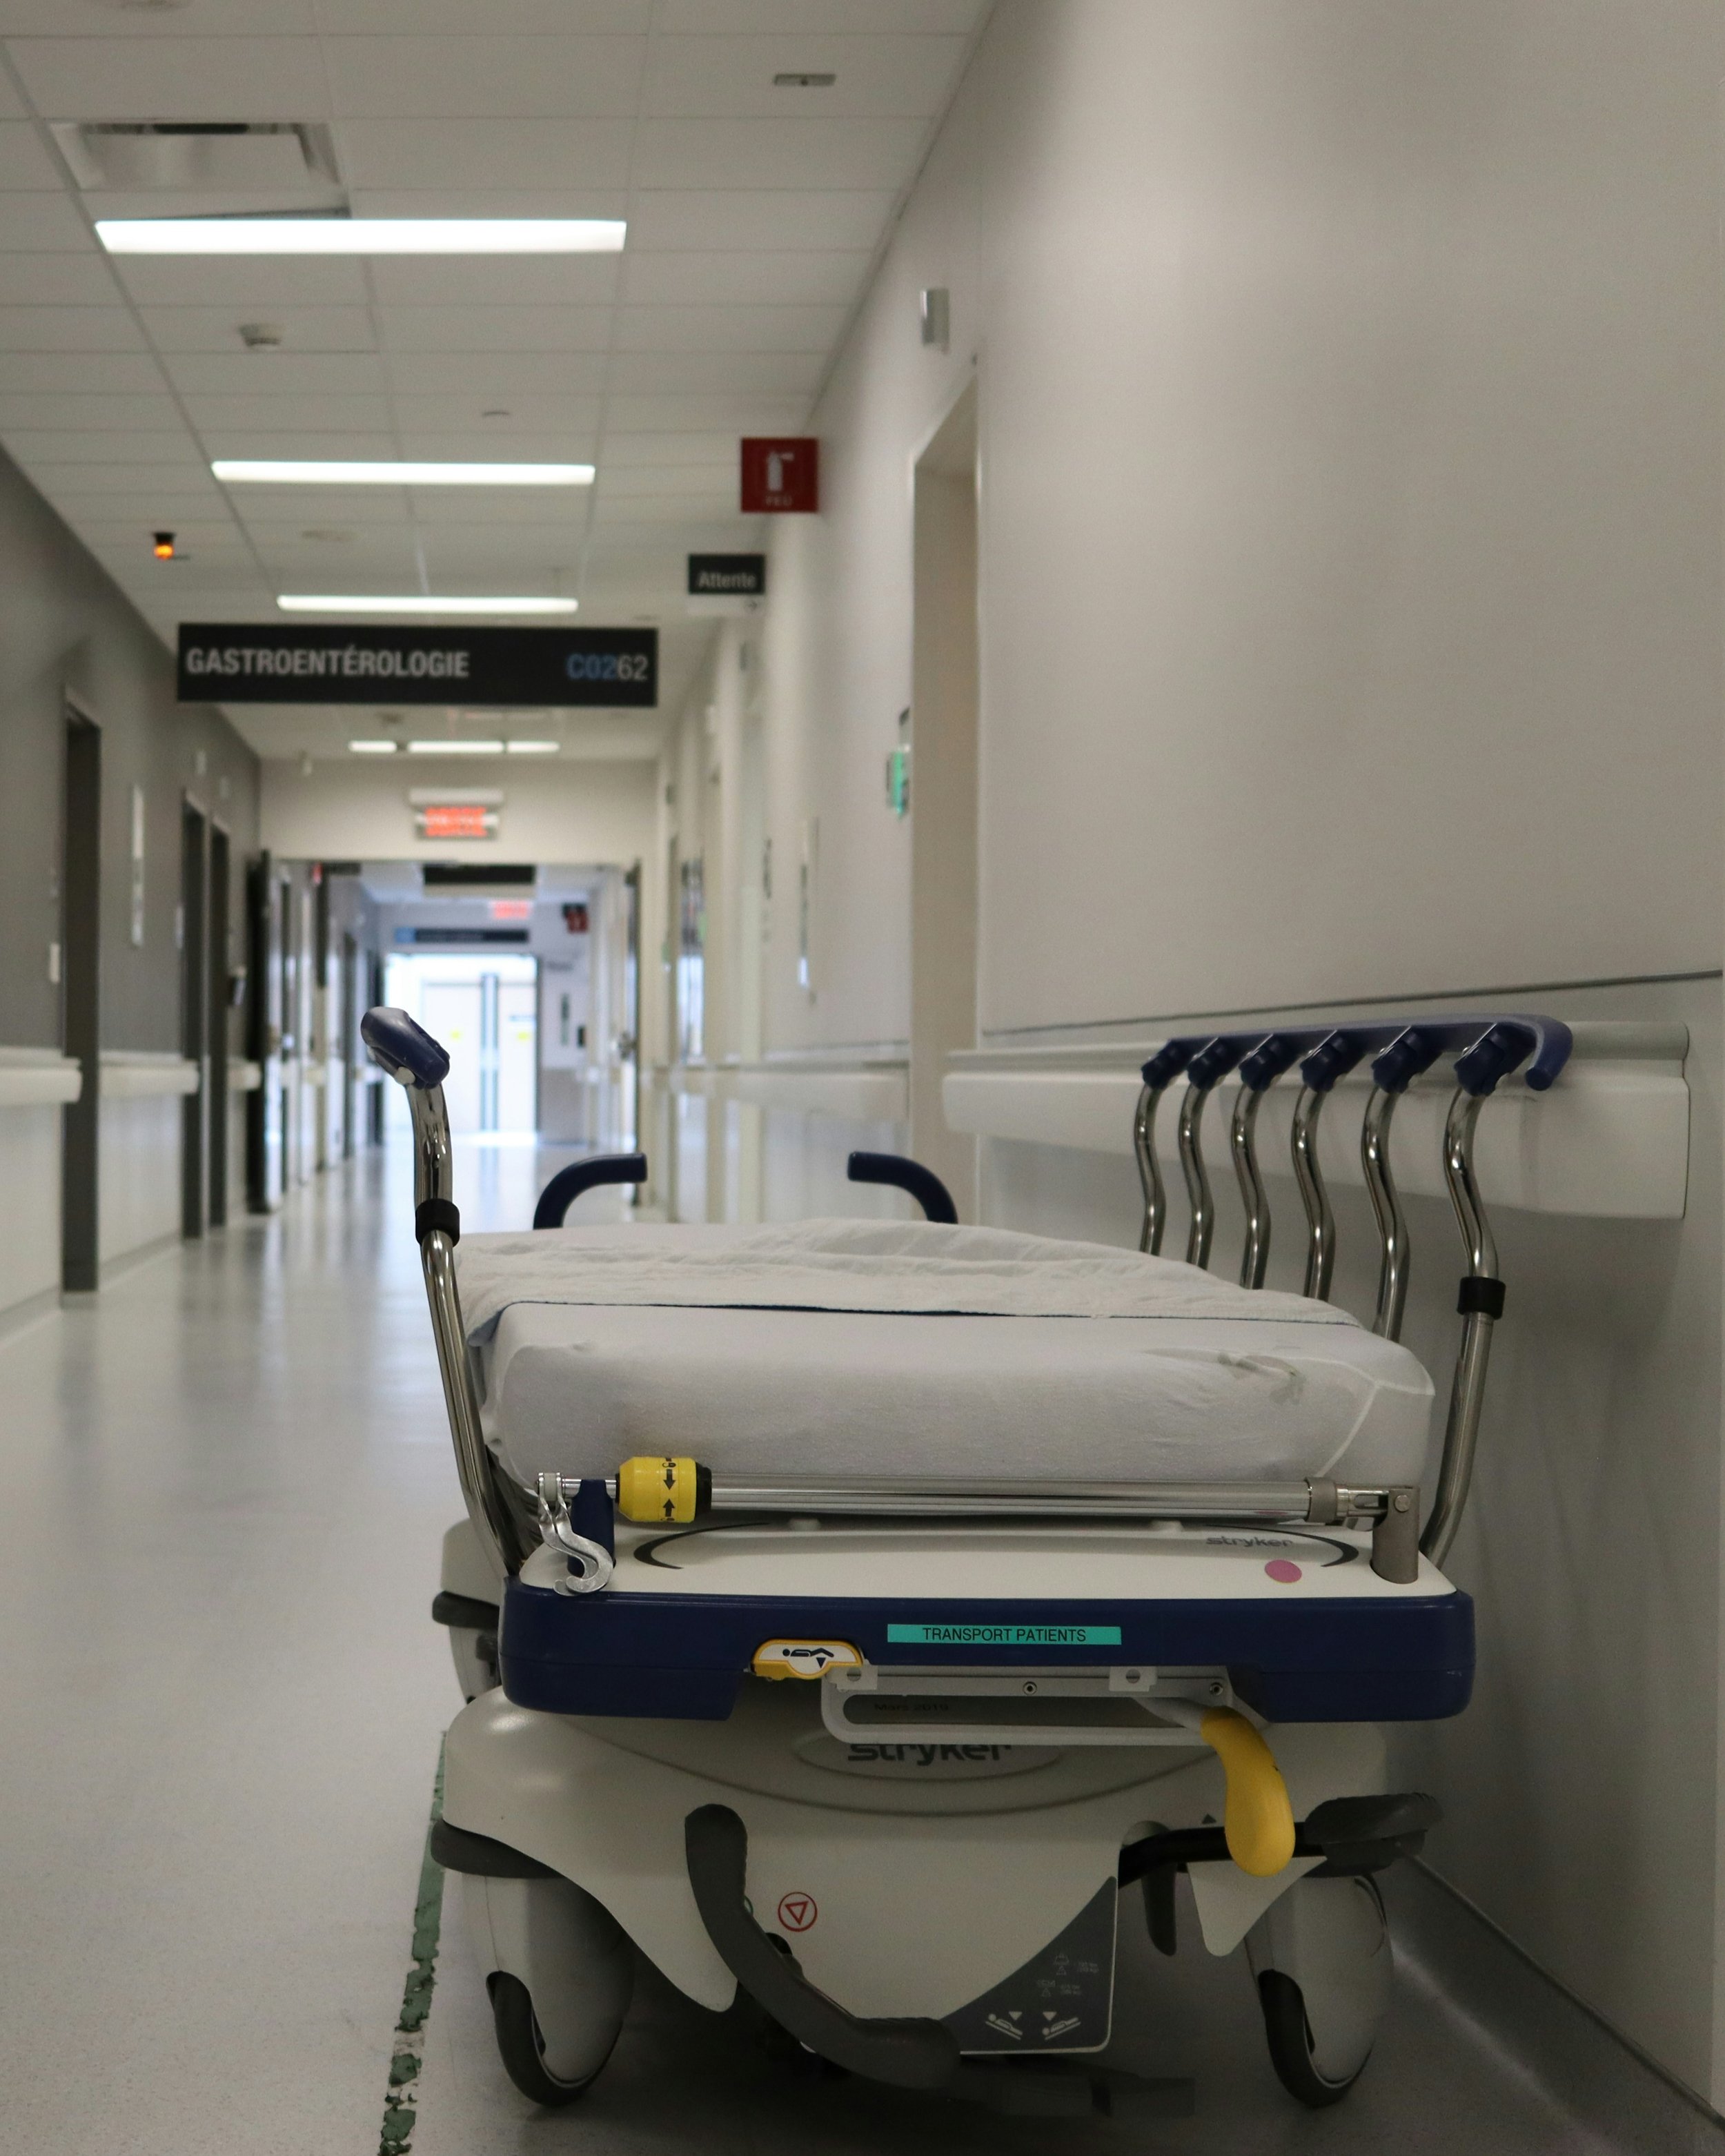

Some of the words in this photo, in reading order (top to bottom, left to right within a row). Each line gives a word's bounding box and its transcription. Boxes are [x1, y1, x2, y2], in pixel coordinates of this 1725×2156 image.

[698, 571, 756, 587] Attente
[186, 645, 469, 677] GASTROENTÉROLOGIE
[1206, 1536, 1293, 1547] stryker
[923, 1627, 1012, 1641] TRANSPORT
[1016, 1629, 1086, 1642] PATIENTS
